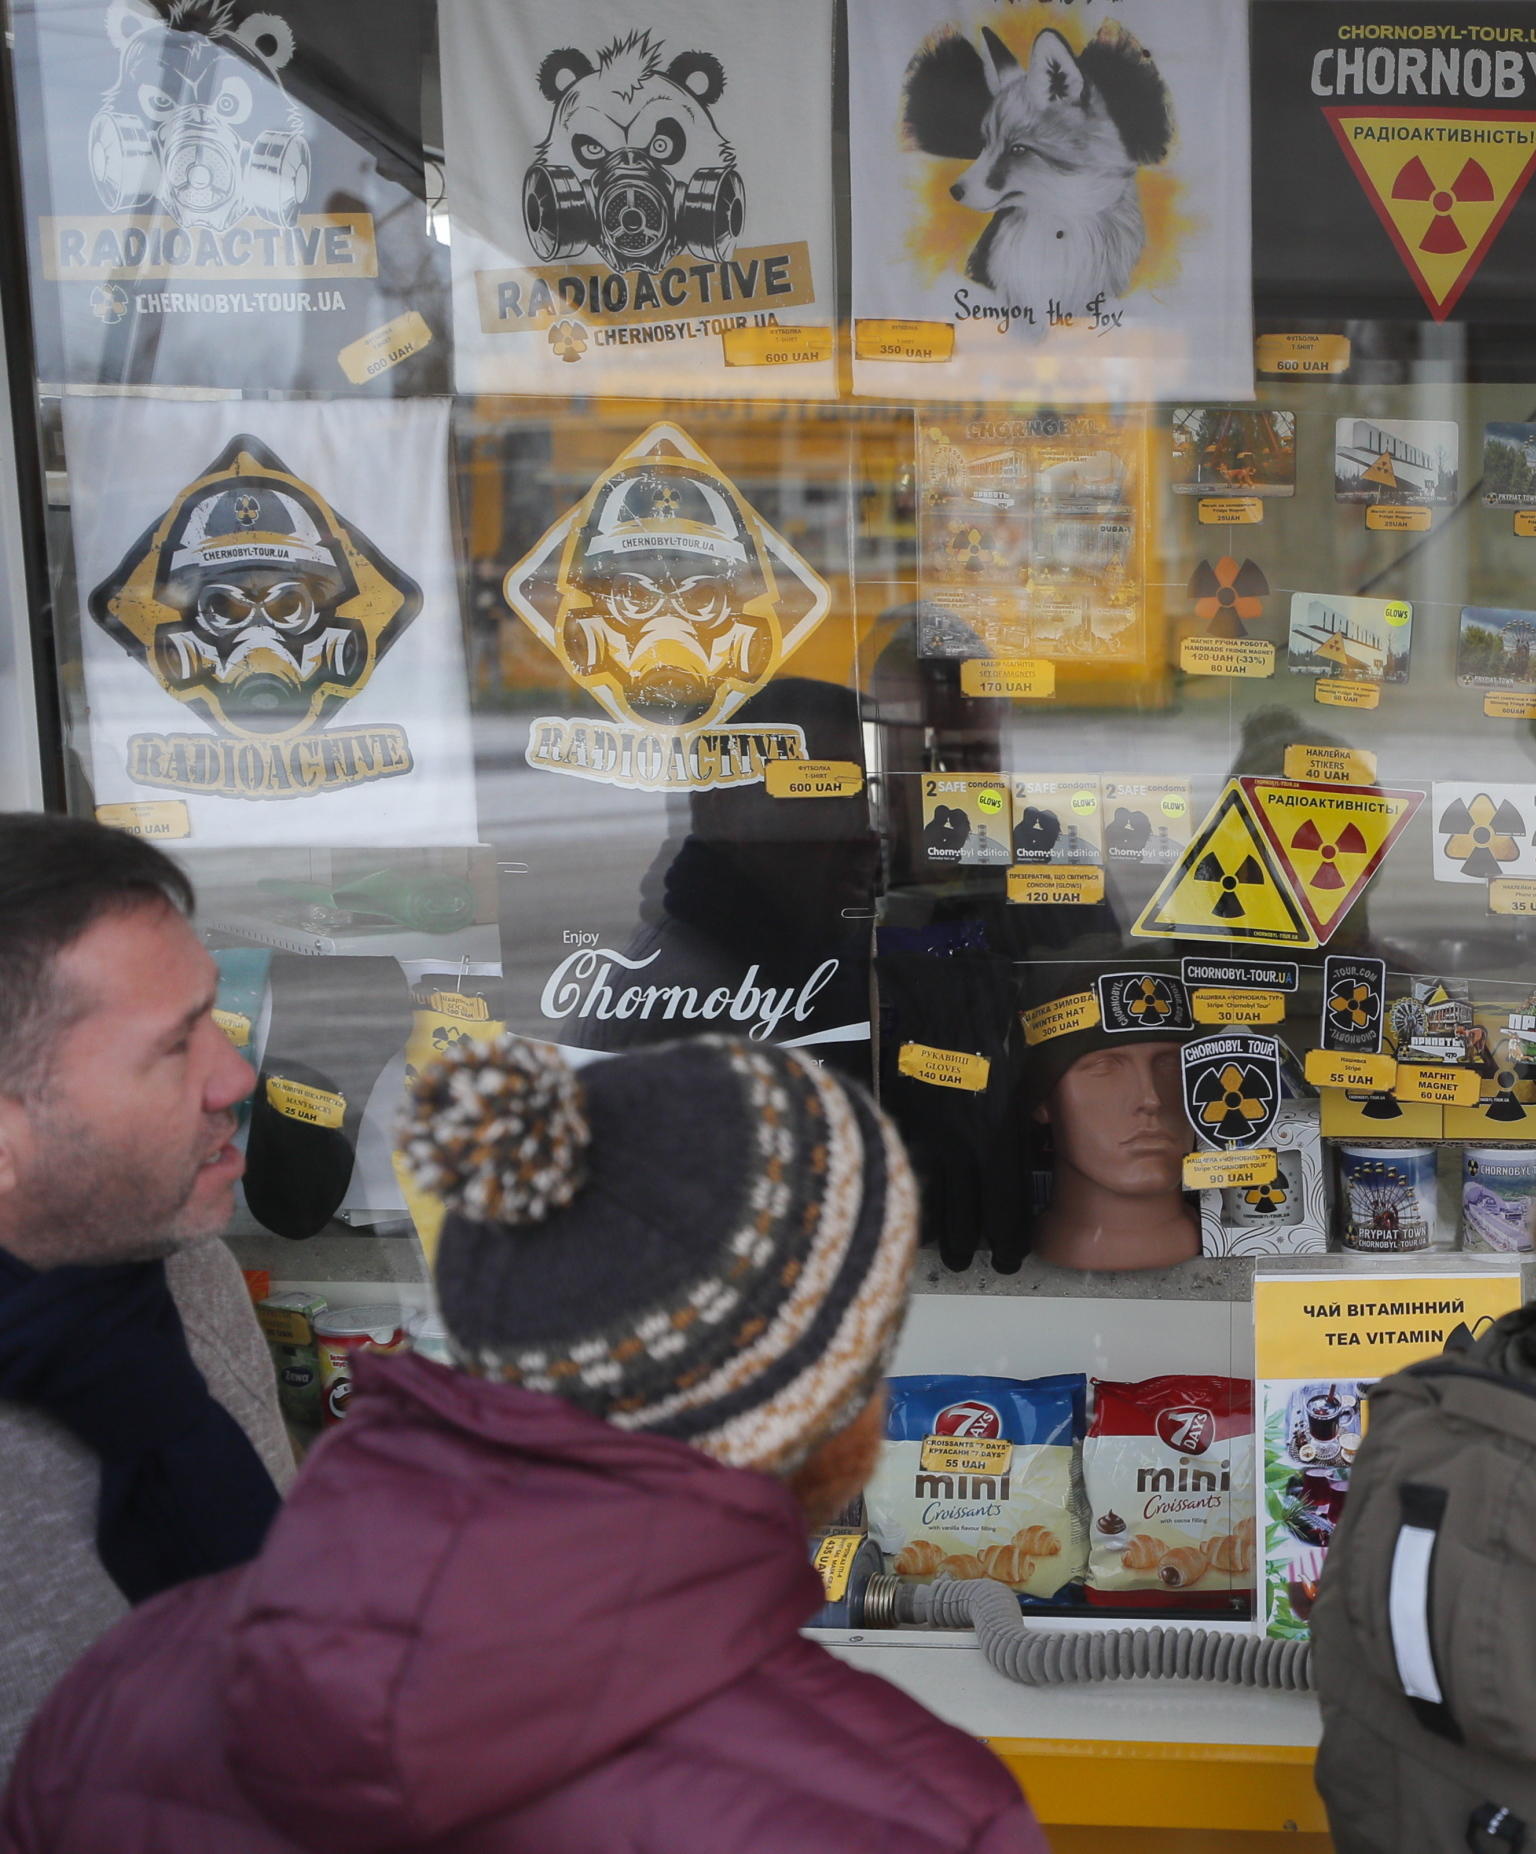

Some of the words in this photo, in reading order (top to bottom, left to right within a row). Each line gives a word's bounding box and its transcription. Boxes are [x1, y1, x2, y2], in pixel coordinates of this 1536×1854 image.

[1354, 126, 1535, 144] РАДІОАКТИВНІСТЬ!
[58, 225, 355, 268] RADIOACTIVE
[498, 255, 794, 319] RADIOACTIVE
[135, 290, 346, 314] CHERNOBYL-TOUR.UA
[954, 288, 1036, 334] Semyon
[1047, 297, 1073, 327] the
[1085, 291, 1123, 338] Fox
[367, 356, 387, 376] 600
[388, 342, 415, 364] UAH
[766, 352, 788, 363] 600
[792, 351, 819, 362] UAH
[880, 344, 902, 355] 350
[905, 348, 932, 359] UAH
[1276, 361, 1299, 371] 600
[1302, 361, 1329, 371] UAH
[622, 538, 715, 553] CHERNOBYL-TOUR.UA
[203, 545, 289, 562] CHERNOBYL-TOUR.UA
[1385, 608, 1408, 619] GLOWS
[1211, 664, 1223, 674] 80
[1226, 665, 1246, 674] UAH
[979, 682, 1003, 693] 170
[1006, 682, 1033, 693] UAH
[538, 724, 800, 782] RADIOACTIVE
[1306, 749, 1351, 759] НАКЛЕЙКА
[136, 733, 404, 790] RADIOACTIVE
[1310, 760, 1344, 770] STIKERS
[1306, 770, 1320, 779] 40
[1324, 771, 1349, 780] UAH
[789, 782, 811, 793] 600
[815, 782, 842, 793] UAH
[926, 781, 937, 796] 2
[938, 781, 967, 793] SAFE
[968, 781, 1005, 789] condoms
[979, 795, 1002, 808] GLOWS
[1072, 798, 1095, 808] GLOWS
[1027, 892, 1048, 902] 120
[1053, 892, 1080, 902] UAH
[1512, 901, 1526, 911] 35
[563, 930, 599, 946] Enjoy
[1188, 966, 1293, 984] CHORNOBYL-TOUR.UA
[540, 949, 839, 1041] Chornobyl
[1066, 1006, 1085, 1020] HAT
[1218, 1012, 1232, 1021] 30
[1235, 1012, 1261, 1021] UAH
[1041, 1027, 1057, 1037] 300
[1060, 1020, 1080, 1033] UAH
[1186, 1042, 1243, 1060] CHORNOBYL
[1248, 1040, 1274, 1056] TOUR
[926, 1061, 961, 1074] GLOVES
[918, 1071, 936, 1082] 140
[939, 1073, 962, 1085] UAH
[1330, 1073, 1344, 1083] 55
[1348, 1074, 1373, 1085] UAH
[1420, 1071, 1456, 1080] МАГНІТ
[1418, 1082, 1458, 1091] MAGNET
[1421, 1091, 1432, 1100] 60
[1435, 1092, 1455, 1101] UAH
[285, 1107, 295, 1116] 25
[298, 1112, 317, 1122] UAH
[1209, 1174, 1224, 1183] 90
[1227, 1172, 1253, 1182] UAH
[1359, 1228, 1399, 1240] PRYPIAT
[1403, 1228, 1427, 1239] TOWN
[1303, 1302, 1341, 1317] ЧАЙ
[1347, 1298, 1465, 1316] ВІТАМІННИЙ
[1325, 1332, 1360, 1346] TEA
[1367, 1330, 1443, 1345] VITAMIN
[947, 1407, 984, 1434] 7
[1168, 1413, 1197, 1448] 7
[1183, 1413, 1208, 1450] DAYS
[946, 1460, 959, 1469] 55
[962, 1460, 985, 1470] UAH
[1137, 1459, 1230, 1492] mini
[915, 1474, 1009, 1500] mini
[922, 1501, 1002, 1524] Croissants
[1143, 1494, 1222, 1519] Croissants
